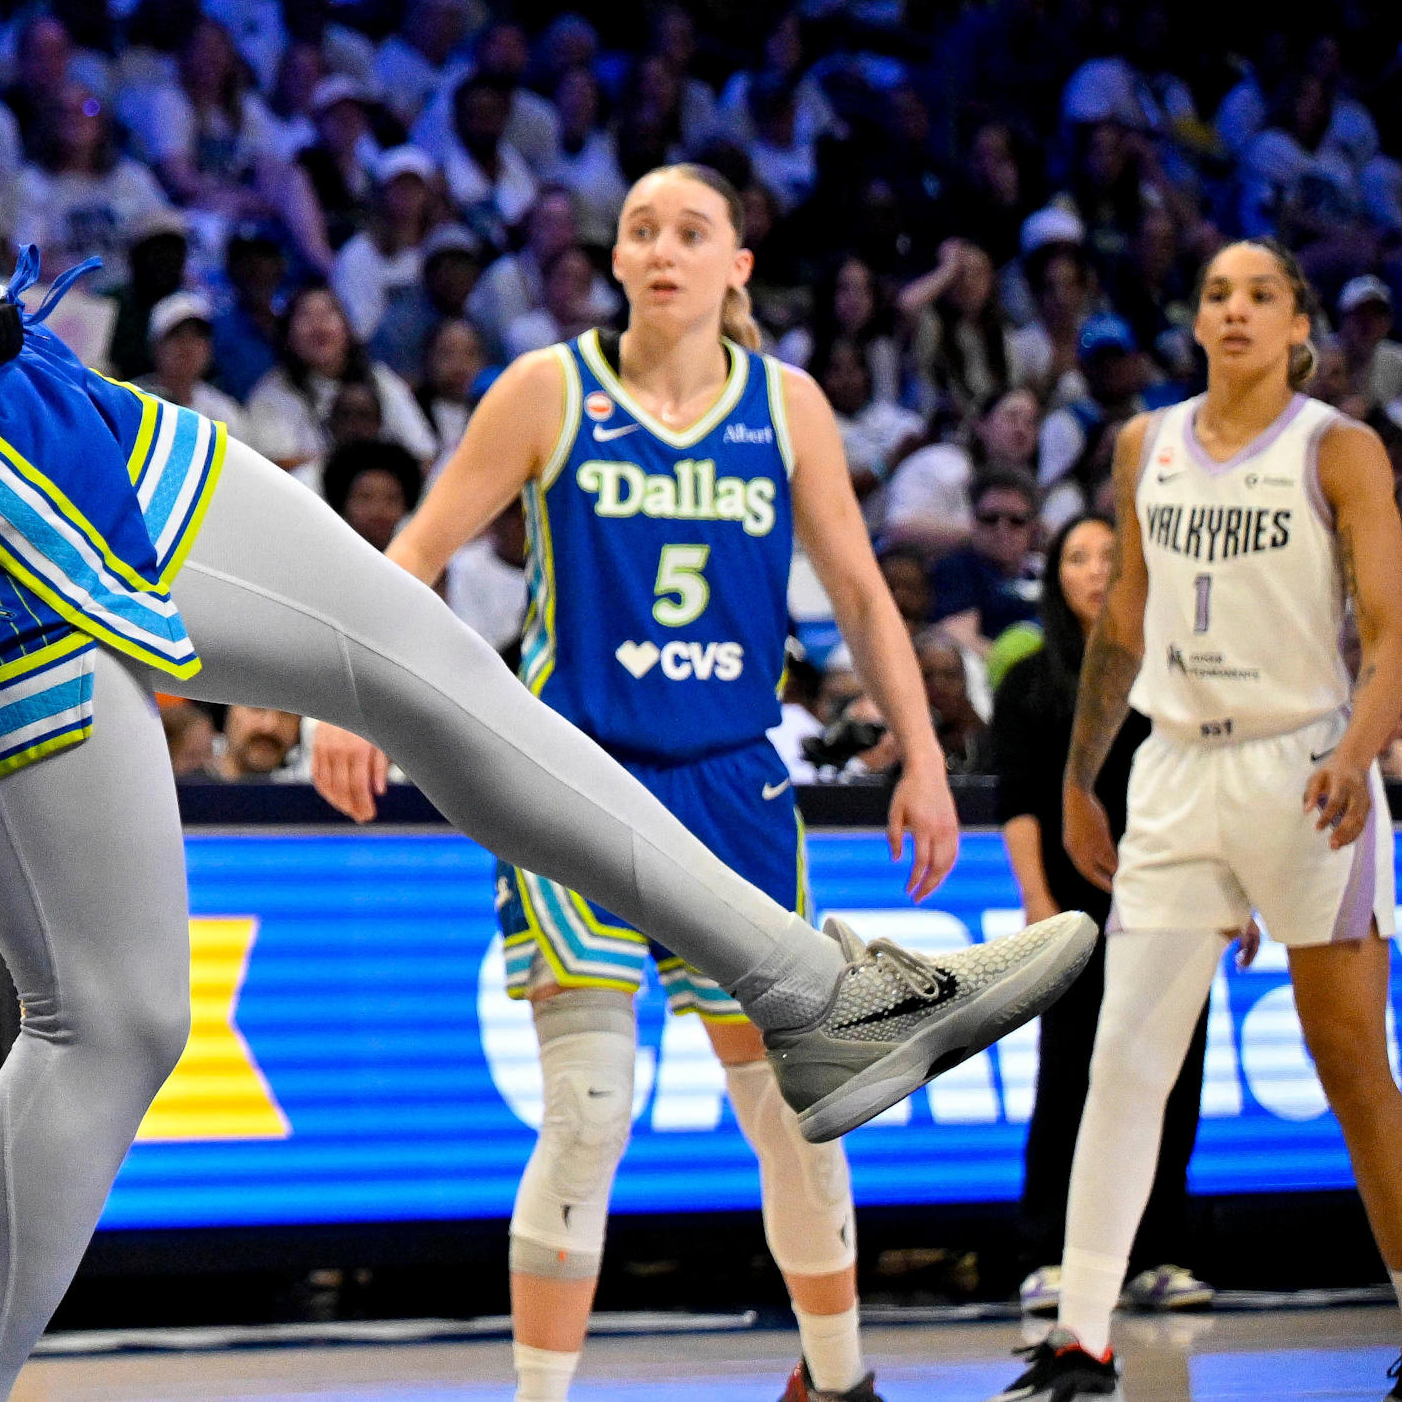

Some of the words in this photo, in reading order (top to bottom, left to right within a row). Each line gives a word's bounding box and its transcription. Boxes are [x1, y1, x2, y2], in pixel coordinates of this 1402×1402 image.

[576, 459, 776, 537] Dallas
[1146, 503, 1292, 562] VALKYRIES
[652, 543, 711, 627] 5
[1193, 572, 1212, 635] 1
[660, 641, 745, 682] CVS
